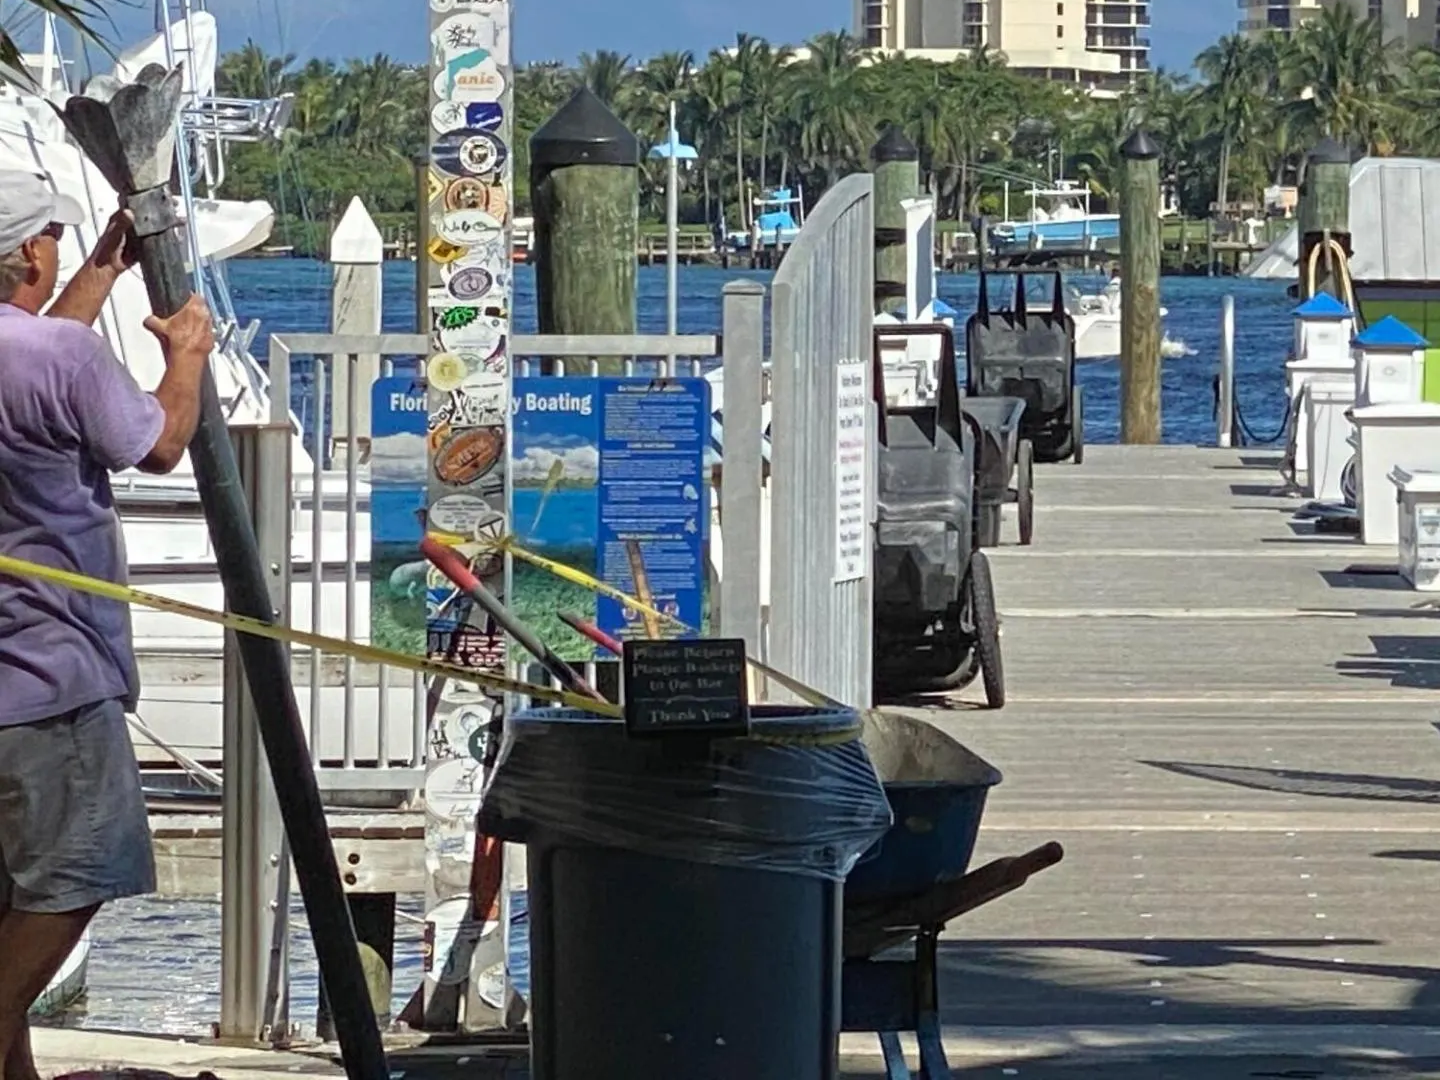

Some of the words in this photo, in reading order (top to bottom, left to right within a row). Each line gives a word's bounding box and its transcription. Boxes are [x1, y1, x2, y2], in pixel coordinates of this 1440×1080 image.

[526, 393, 592, 416] Boating
[683, 646, 735, 660] Return
[651, 708, 697, 724] Thank
[701, 708, 731, 722] You
